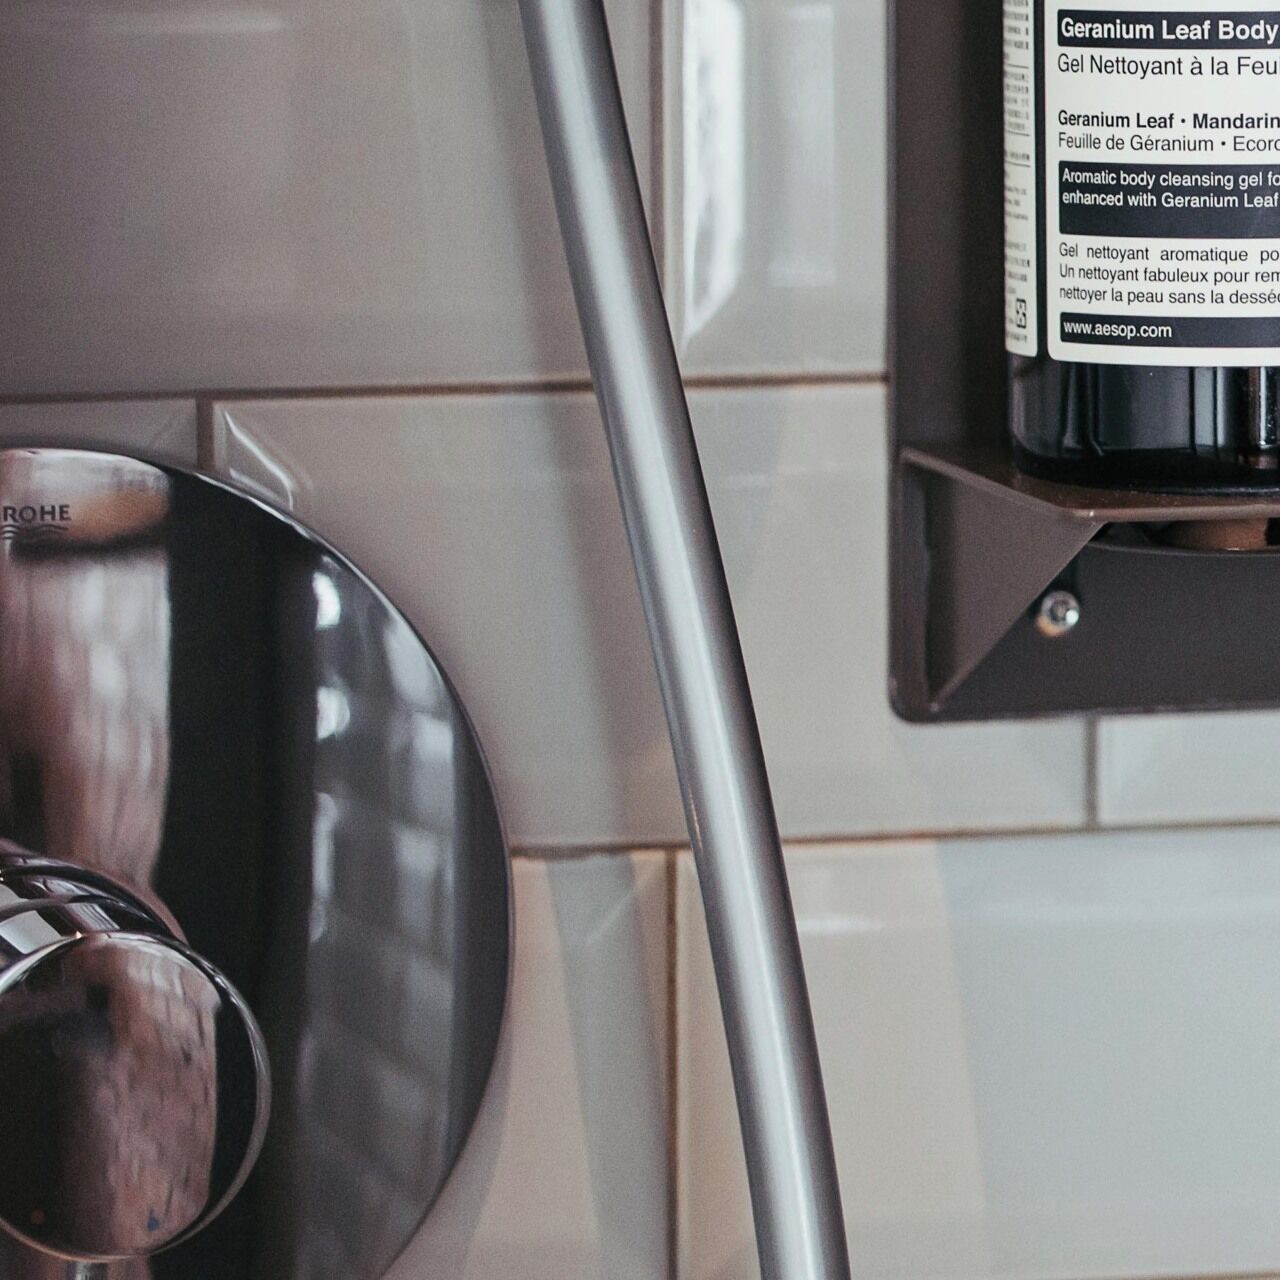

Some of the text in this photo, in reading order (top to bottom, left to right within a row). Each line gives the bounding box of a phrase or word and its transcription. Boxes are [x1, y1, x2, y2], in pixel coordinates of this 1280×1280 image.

[1061, 18, 1154, 40] Geranium
[1162, 19, 1210, 40] Leaf
[1219, 19, 1278, 44] Body
[1058, 53, 1084, 74] Gel
[1090, 55, 1183, 79] Nettoyant
[1190, 55, 1202, 75] à
[1210, 56, 1229, 75] la
[1059, 110, 1130, 128] Geranium
[1136, 112, 1174, 129] Leaf
[1193, 112, 1280, 130] Mandarin
[1058, 133, 1102, 150] Feuille
[1106, 134, 1124, 150] de
[1130, 133, 1213, 152] Géranium
[1063, 168, 1117, 185] Aromatic
[1120, 169, 1155, 190] body
[1160, 170, 1233, 190] cleansing
[1239, 171, 1263, 190] gel
[1062, 189, 1123, 208] enhanced
[1128, 191, 1156, 208] with
[1162, 192, 1238, 209] Geranium
[1244, 192, 1278, 208] Leaf
[1060, 242, 1078, 260] Gel
[1086, 244, 1150, 264] nettoyant
[1160, 245, 1249, 266] aromatique
[1060, 264, 1075, 279] Un
[1079, 264, 1138, 285] nettoyant
[1144, 265, 1208, 282] fabuleux
[1214, 269, 1249, 287] pour
[1060, 285, 1107, 306] nettoyer
[1111, 286, 1123, 303] la
[1127, 289, 1163, 307] peau
[1169, 291, 1206, 304] sans
[1211, 288, 1224, 304] la
[1063, 321, 1173, 341] www.aesop.com
